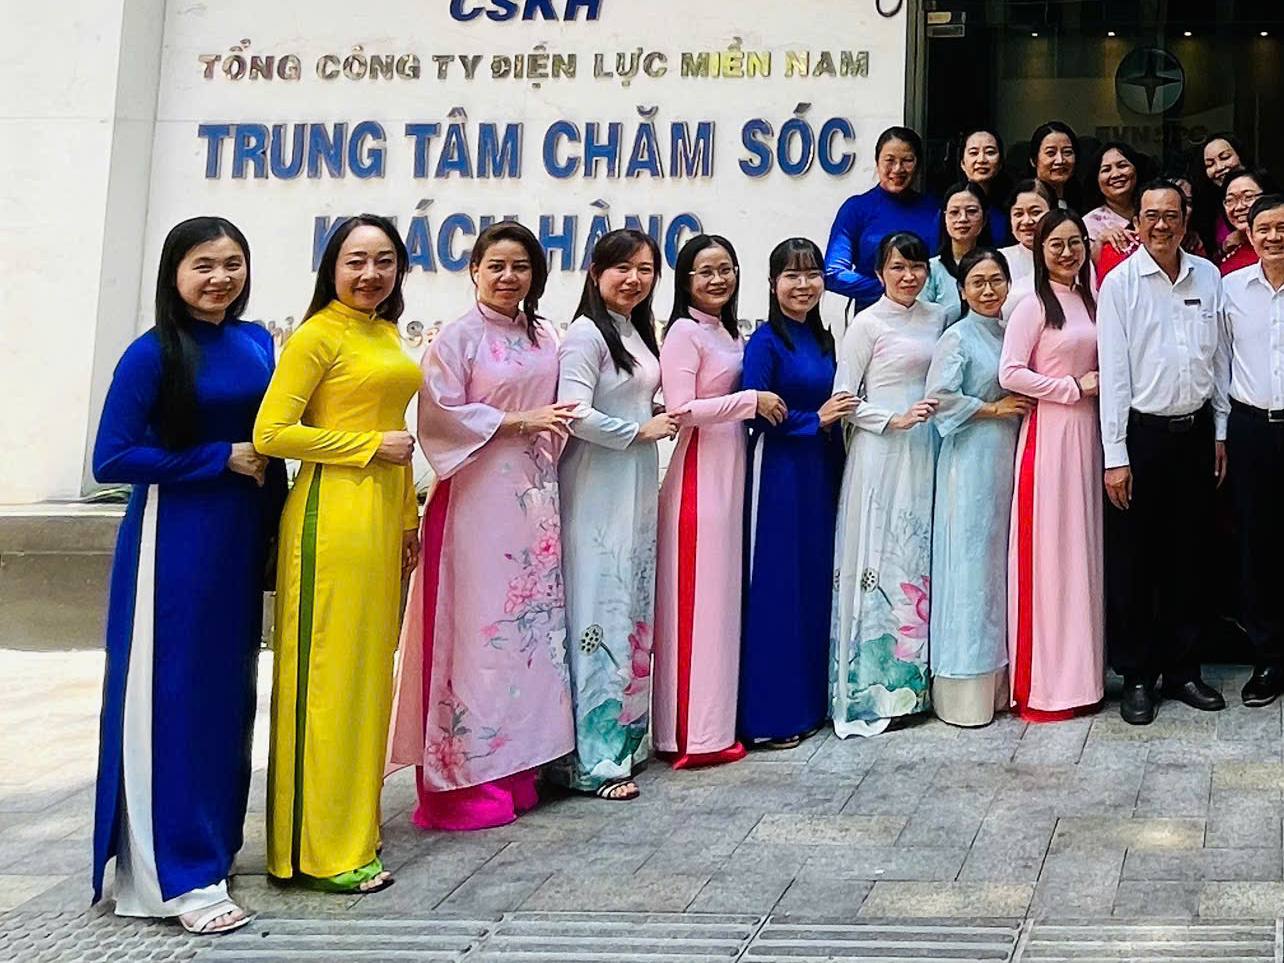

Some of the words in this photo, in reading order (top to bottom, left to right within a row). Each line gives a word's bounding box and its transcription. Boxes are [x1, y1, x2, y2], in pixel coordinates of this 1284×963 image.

[198, 38, 301, 80] TỔNG
[316, 44, 420, 80] CÔNG
[432, 54, 483, 80] TY
[490, 43, 577, 88] ĐIỆN
[594, 47, 667, 87] LỰC
[680, 36, 771, 78] MIỀN
[784, 51, 869, 78] NAM
[198, 121, 387, 180] TRUNG
[405, 107, 524, 180] TÂM
[542, 102, 715, 179] CHĂM
[738, 102, 856, 178] SÓC
